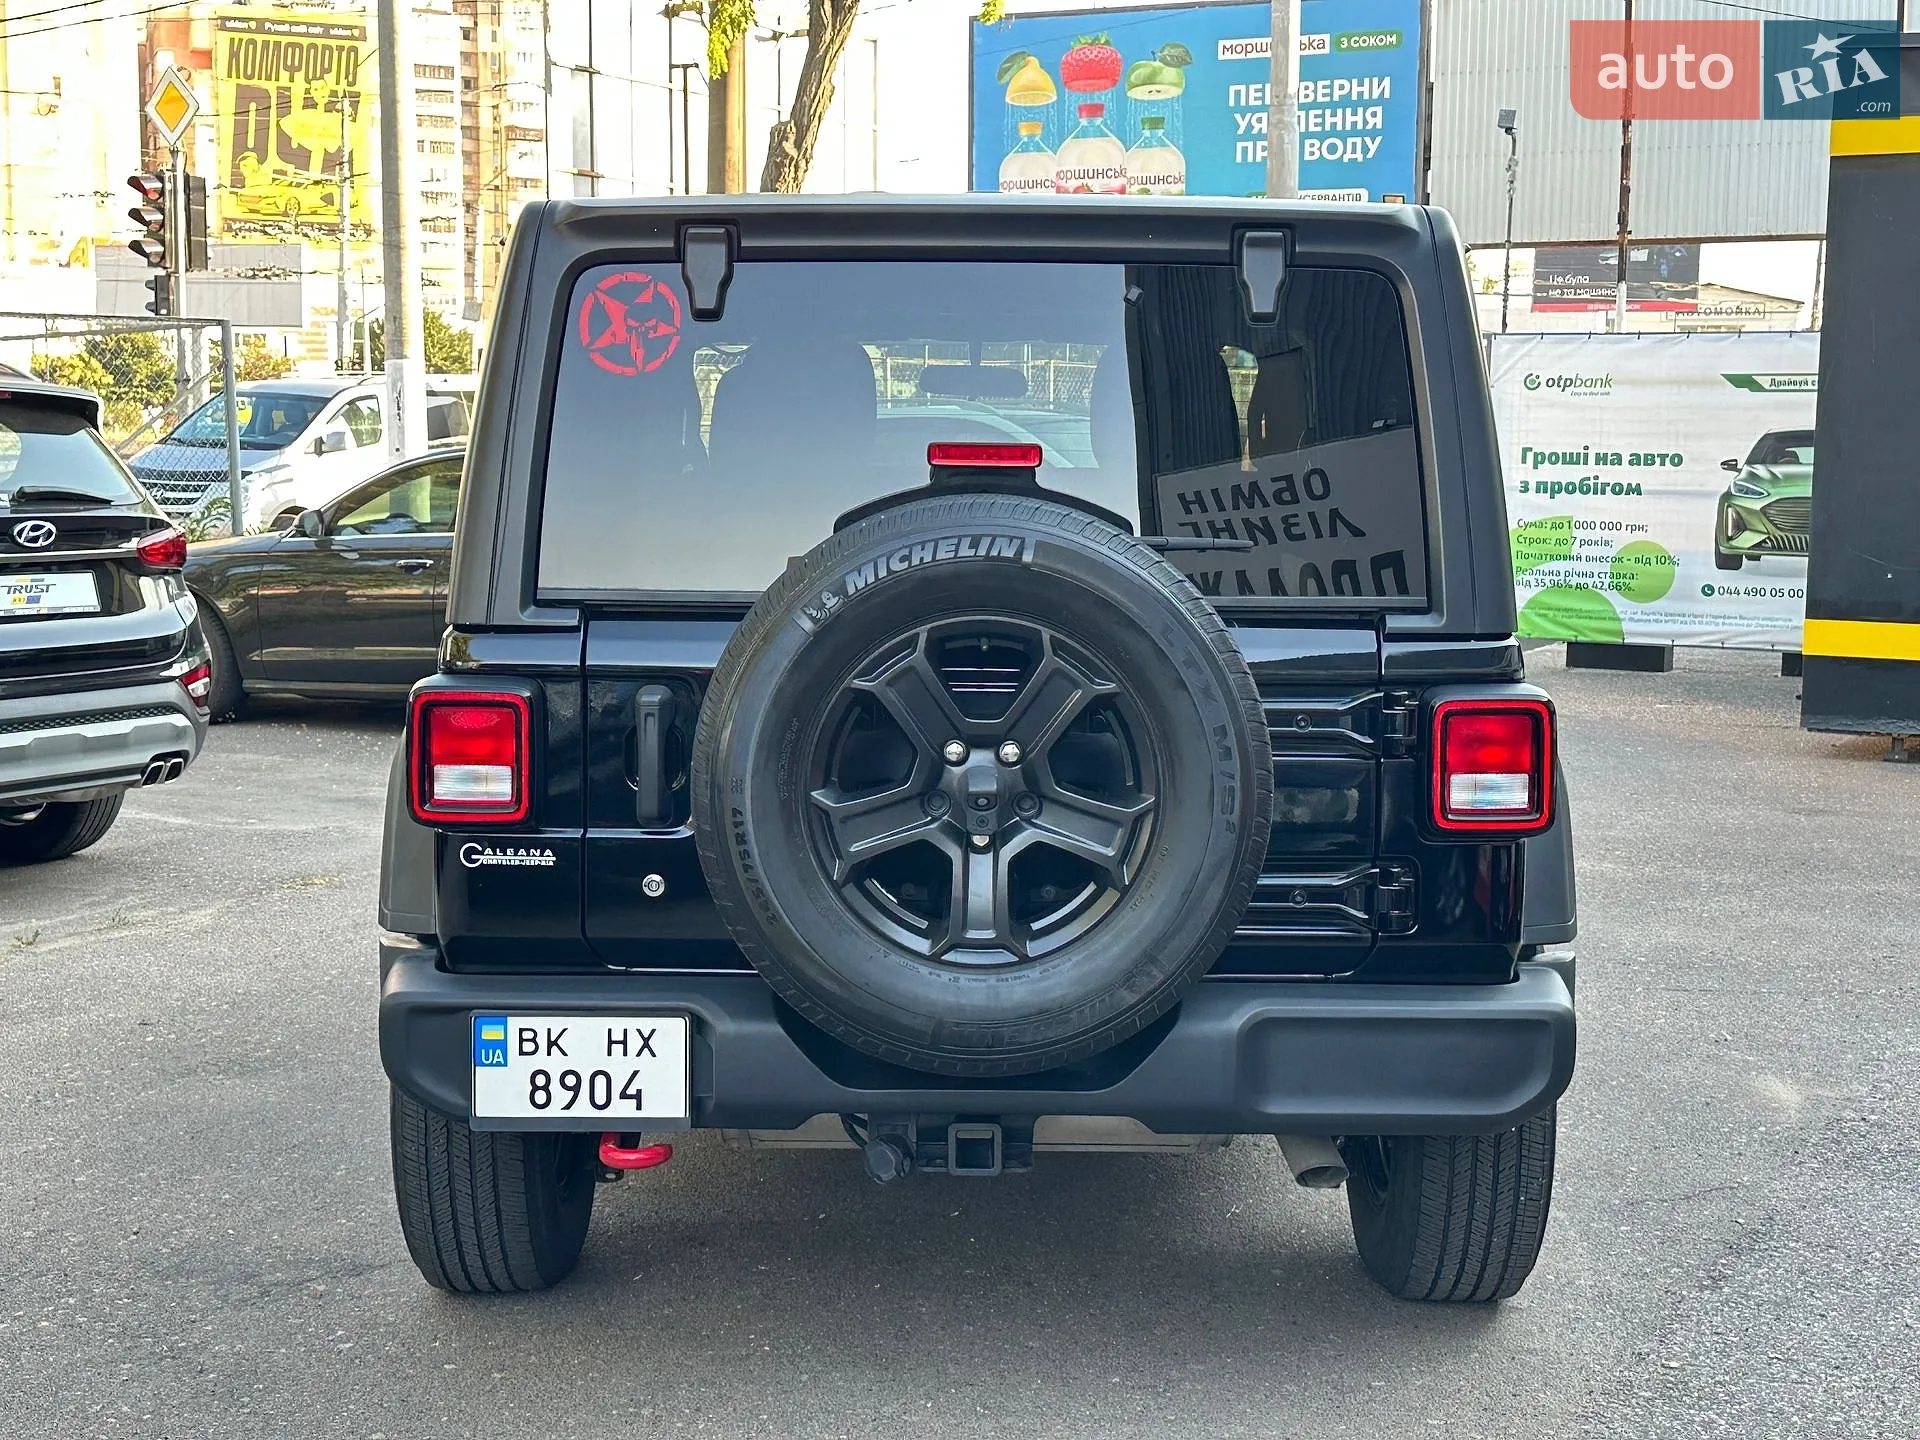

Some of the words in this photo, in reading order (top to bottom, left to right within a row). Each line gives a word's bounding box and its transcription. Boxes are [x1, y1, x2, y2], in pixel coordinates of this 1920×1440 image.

[1222, 36, 1326, 57] моршька
[1350, 33, 1397, 48] СОКОМ
[227, 37, 359, 88] КОМФОРТО
[1228, 76, 1391, 107] ПЕВЕРНИ
[1235, 140, 1272, 164] ПР
[1303, 135, 1383, 163] ВОДУ
[1520, 445, 1589, 470] Гроші
[1594, 450, 1623, 467] на
[1628, 452, 1684, 468] авто
[1519, 480, 1530, 494] з
[1535, 475, 1643, 499] пробігом
[1517, 518, 1548, 531] Сума:
[1550, 521, 1565, 531] до
[1566, 520, 1572, 530] 1
[1574, 520, 1597, 531] 000
[1599, 520, 1622, 532] 000
[1625, 522, 1649, 533] грн;
[1516, 534, 1552, 546] Строк:
[1554, 538, 1569, 547] до
[1570, 536, 1578, 546] 7
[844, 536, 1023, 596] MICHELIN
[1515, 550, 1582, 562] Початковий
[1585, 554, 1624, 563] внесок
[1634, 555, 1652, 566] від
[1515, 566, 1561, 578] Реальна
[1564, 567, 1595, 579] річна
[1597, 570, 1639, 581] ставка:
[0, 583, 57, 595] TRUST
[1574, 581, 1589, 591] до
[1717, 584, 1741, 597] 044
[1742, 585, 1767, 598] 490
[1769, 587, 1788, 599] 05
[1789, 588, 1804, 599] 00
[481, 1049, 505, 1064] UA
[529, 1068, 643, 1111] 8904
